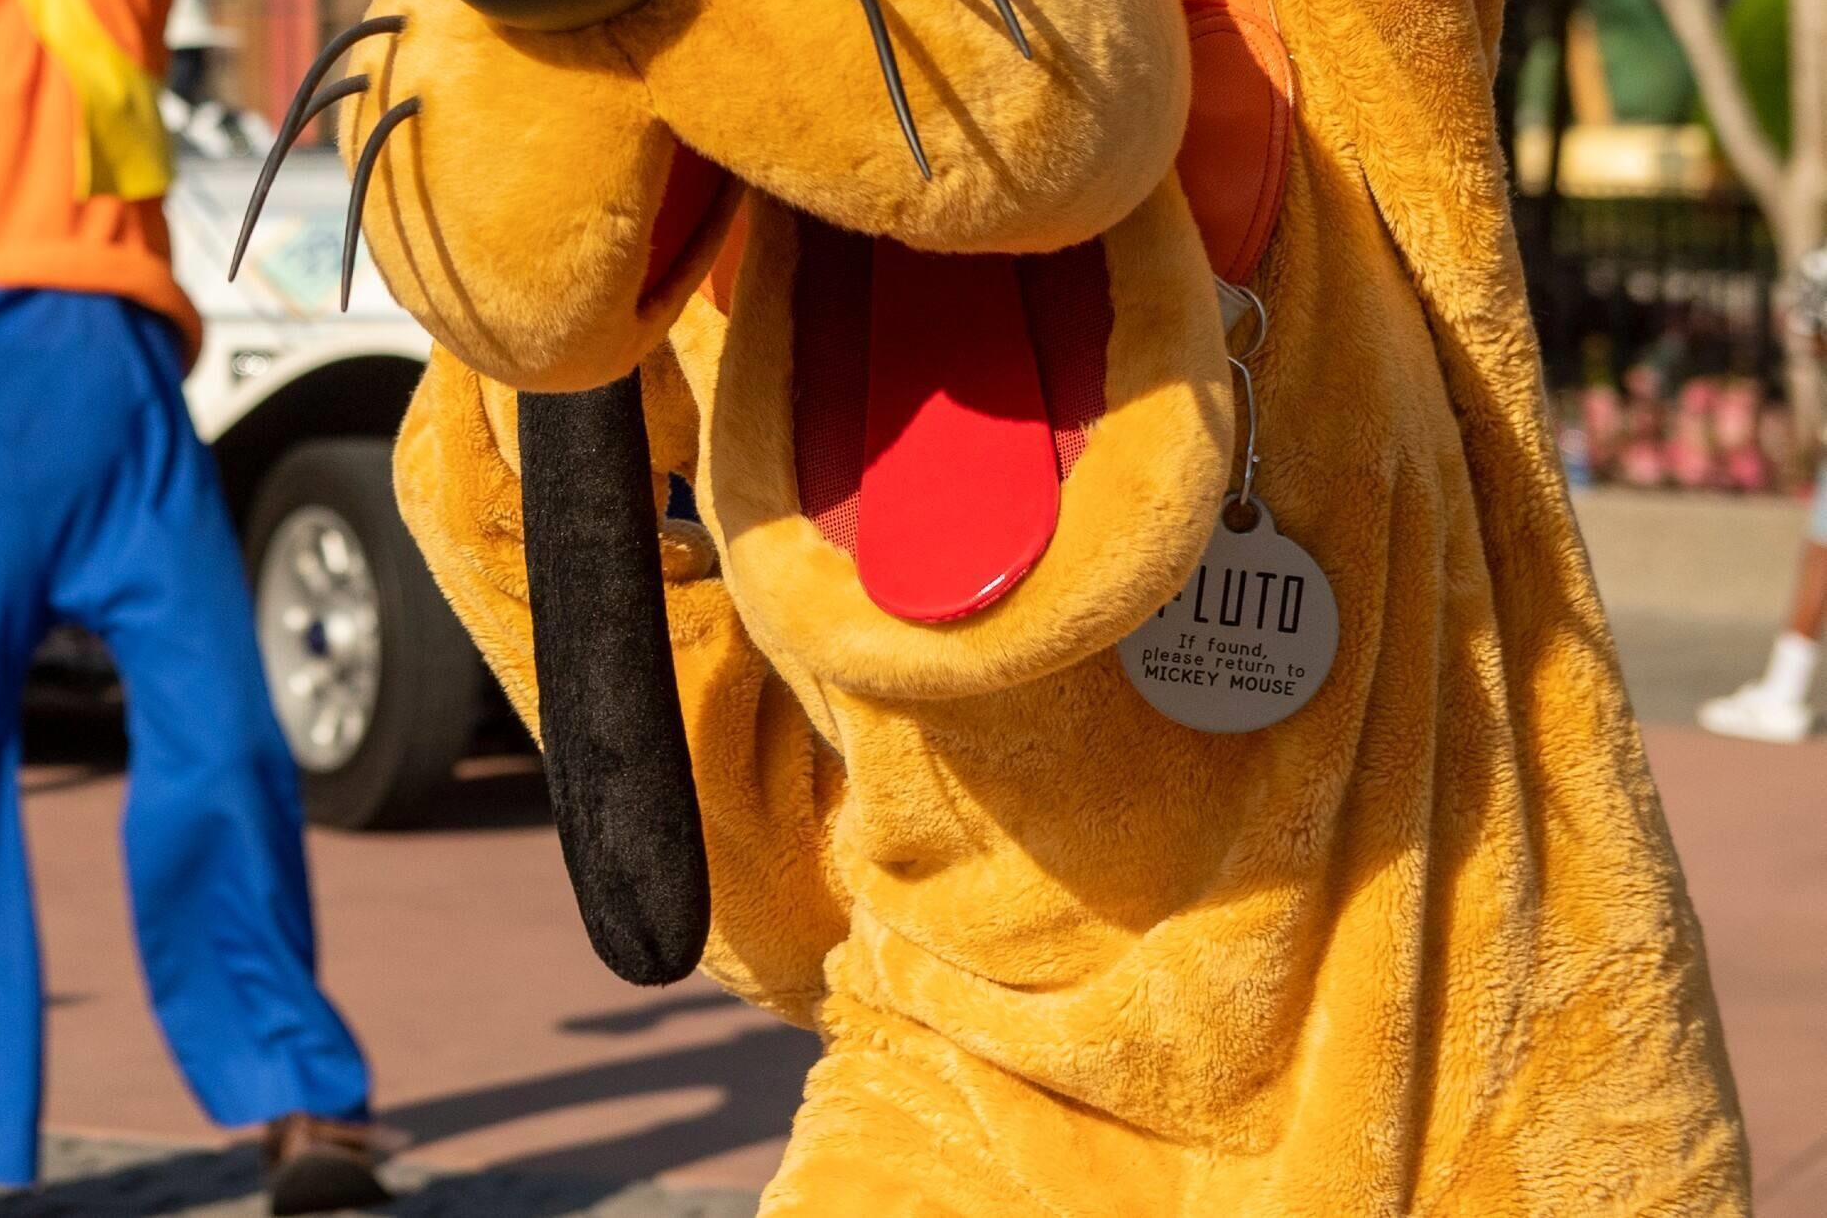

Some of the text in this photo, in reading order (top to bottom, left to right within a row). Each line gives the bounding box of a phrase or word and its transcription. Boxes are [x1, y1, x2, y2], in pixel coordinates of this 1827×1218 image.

[1157, 565, 1304, 633] LUTO
[1178, 633, 1268, 659] If found,
[1142, 647, 1305, 678] please return to
[1144, 664, 1296, 696] MICKEY MOUSE
